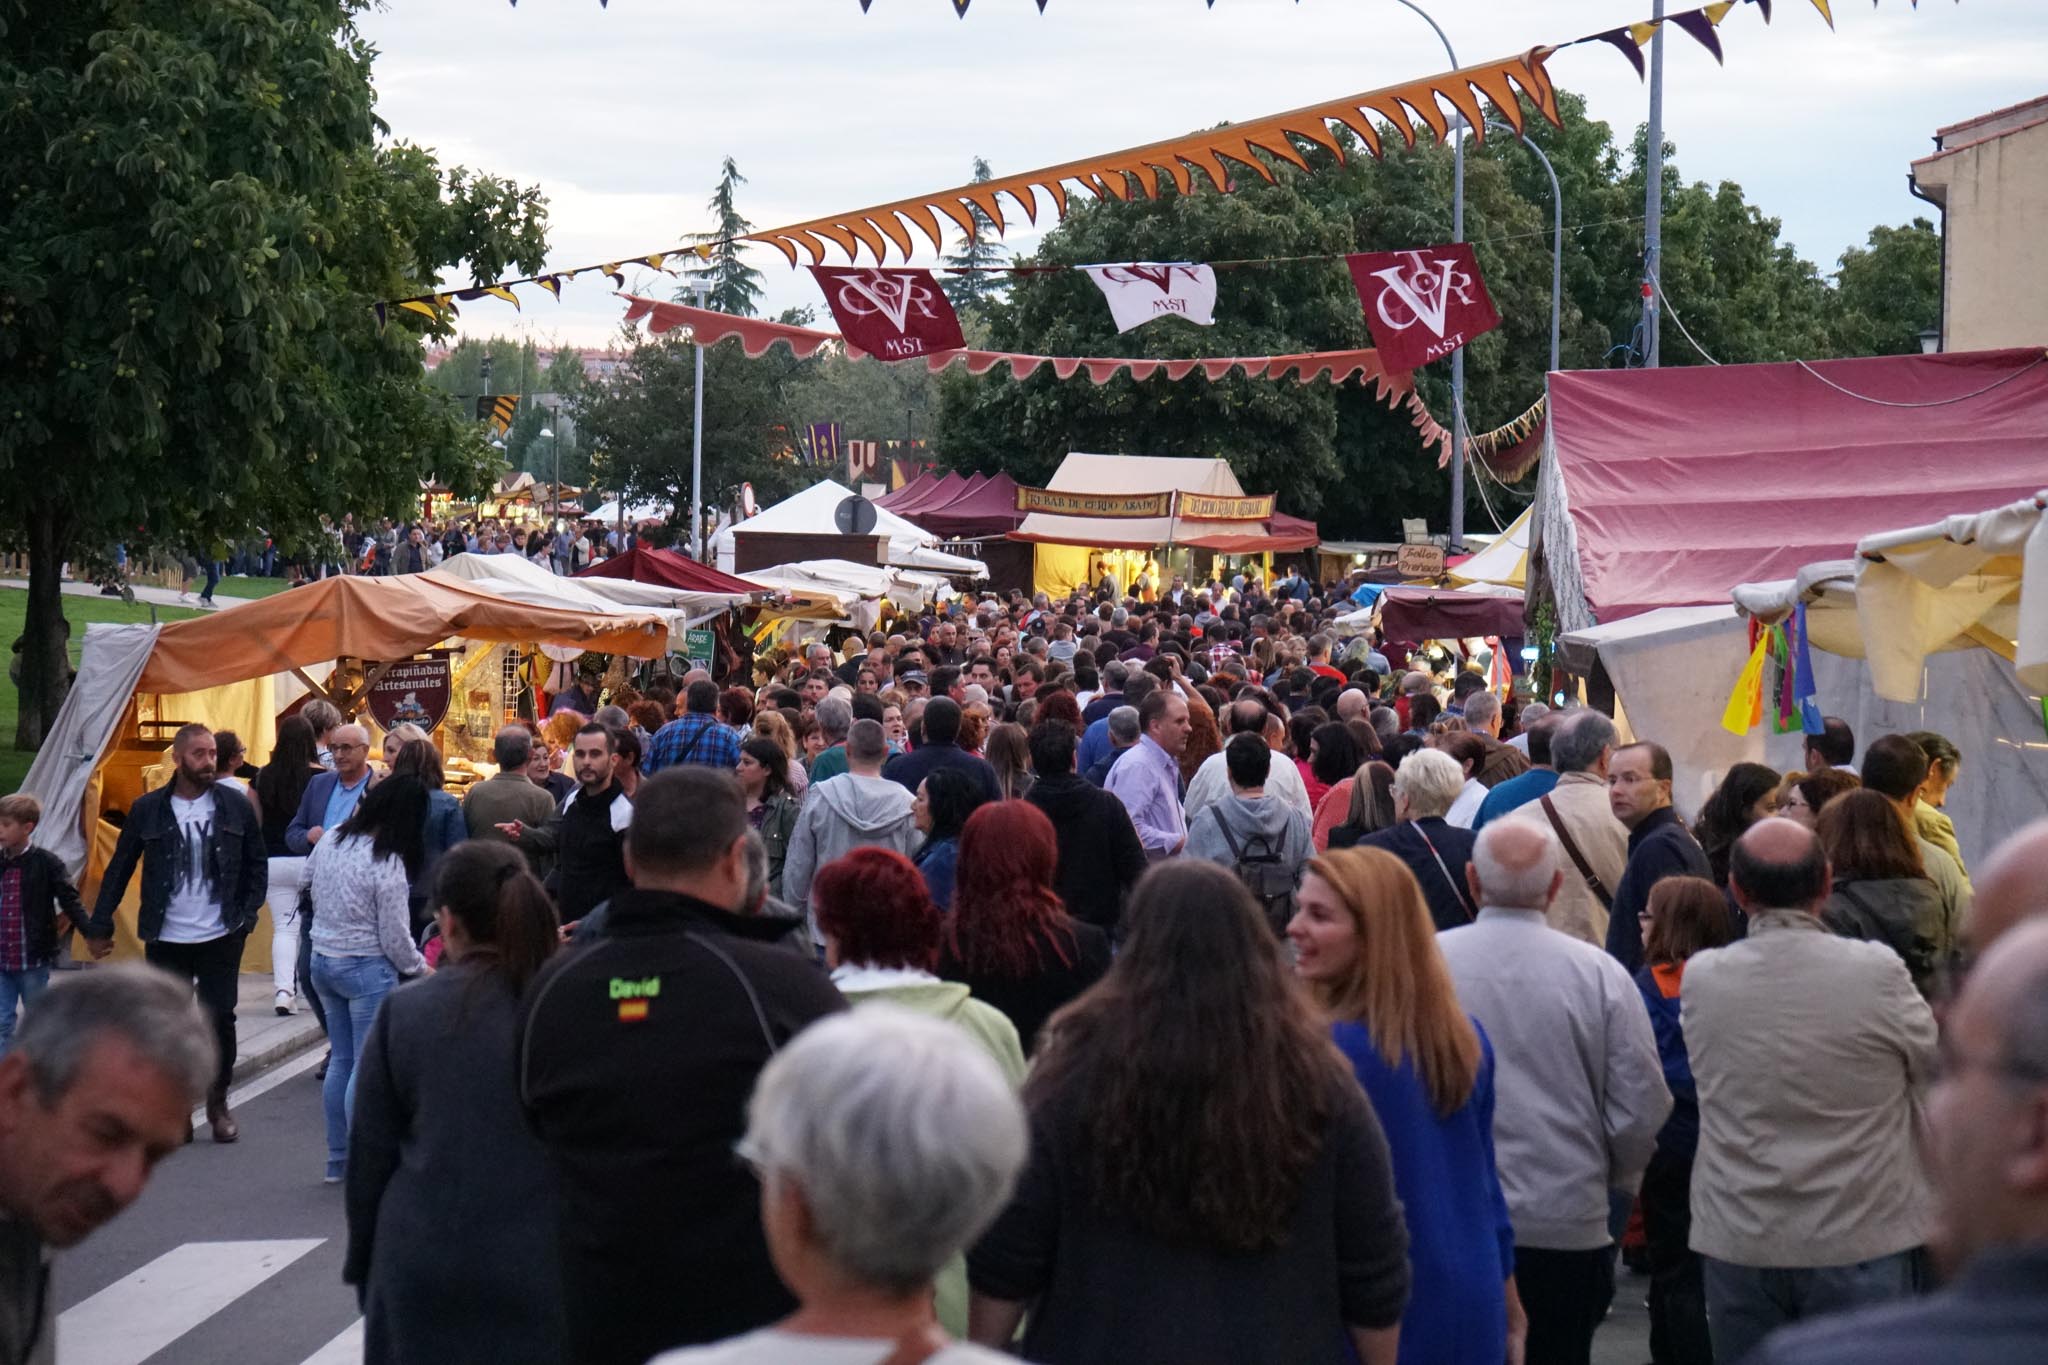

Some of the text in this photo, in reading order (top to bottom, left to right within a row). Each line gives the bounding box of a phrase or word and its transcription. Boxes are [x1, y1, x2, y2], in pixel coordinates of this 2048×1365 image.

[1153, 298, 1187, 314] MST
[886, 337, 924, 356] MST
[1426, 331, 1464, 361] MST
[1030, 493, 1065, 508] KEBAB
[1068, 498, 1081, 509] DE
[1122, 499, 1157, 511] ASADO
[374, 677, 442, 692] Artesanales
[609, 976, 660, 999] David
